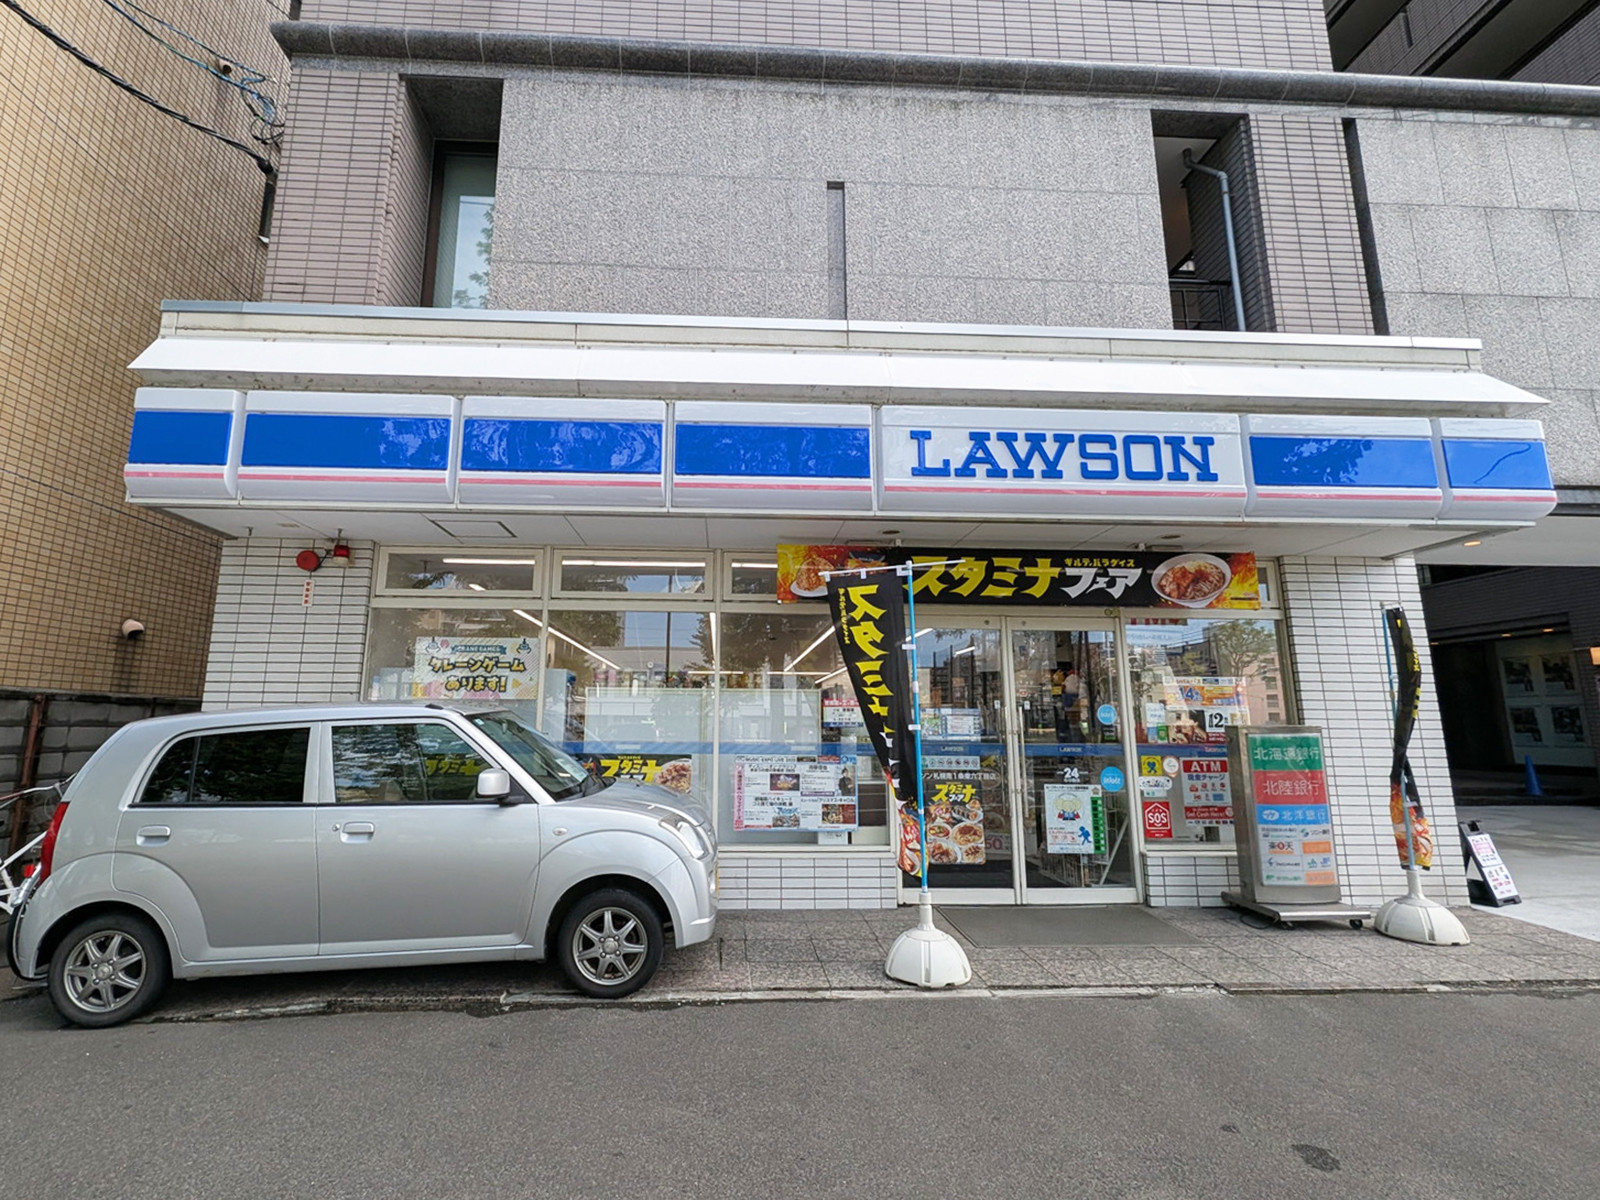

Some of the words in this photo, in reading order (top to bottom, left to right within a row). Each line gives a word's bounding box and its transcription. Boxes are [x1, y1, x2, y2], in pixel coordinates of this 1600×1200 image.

[909, 430, 1219, 482] LAWSON
[428, 656, 526, 673] クレーンゲーム
[1063, 767, 1080, 778] 24
[1190, 761, 1221, 772] ATM
[1263, 780, 1321, 795] 北陸銀行
[1147, 812, 1168, 823] SOS
[1282, 808, 1327, 821] 北洋銀行
